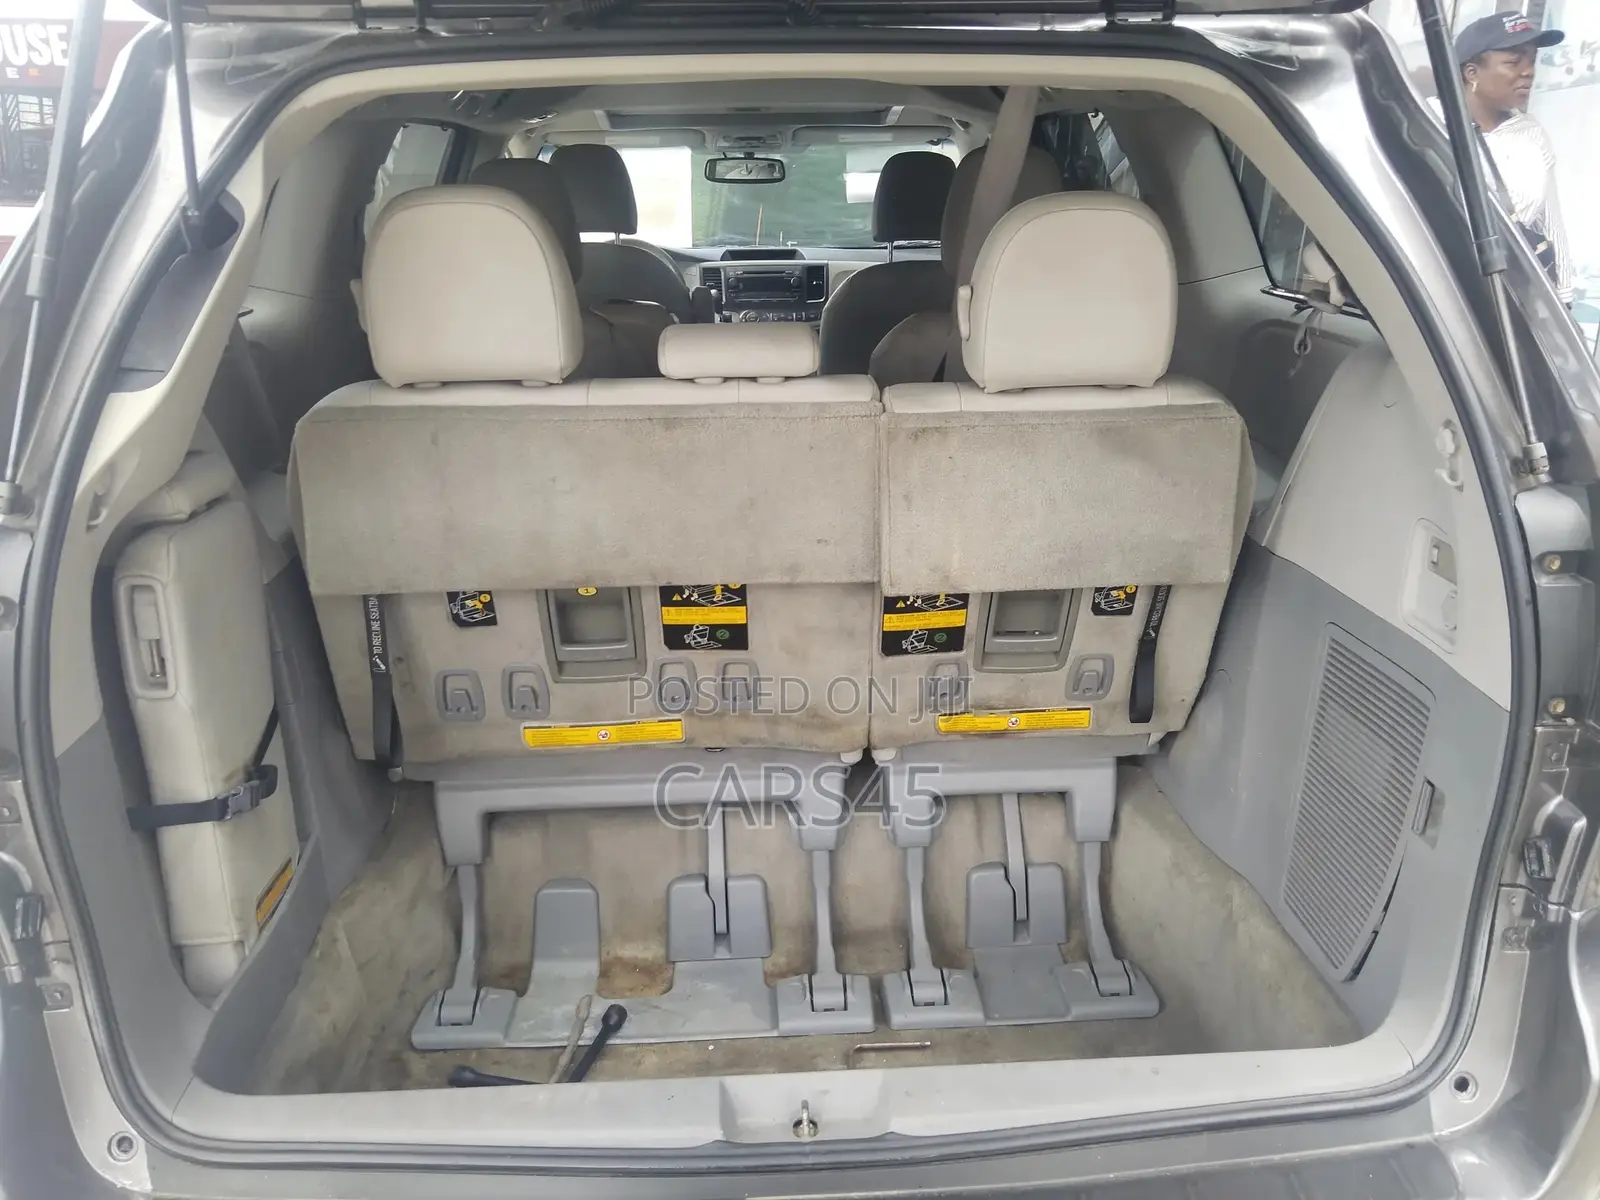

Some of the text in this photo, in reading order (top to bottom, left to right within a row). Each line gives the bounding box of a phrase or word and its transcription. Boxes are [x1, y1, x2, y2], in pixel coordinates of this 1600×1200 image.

[0, 23, 69, 66] USE
[371, 620, 382, 646] RECLINE
[373, 646, 383, 654] TO
